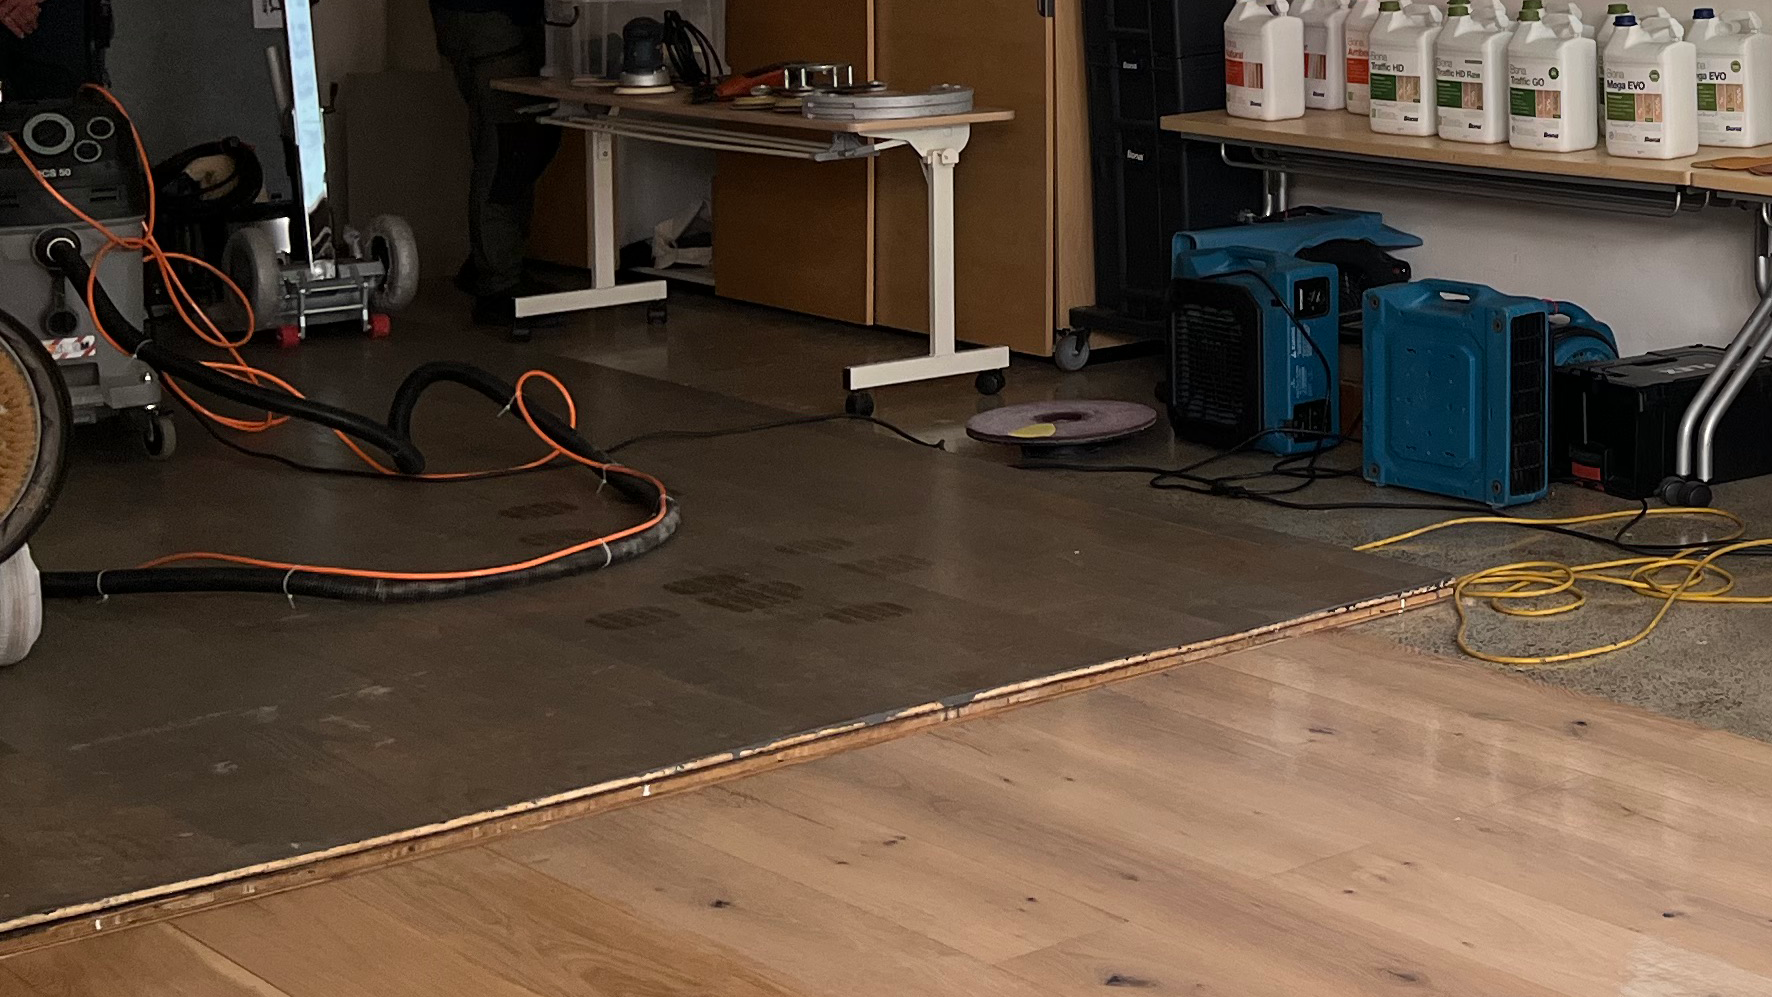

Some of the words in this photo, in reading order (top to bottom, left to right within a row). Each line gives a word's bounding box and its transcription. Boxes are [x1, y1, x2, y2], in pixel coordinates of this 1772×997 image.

[1371, 62, 1391, 72] Traffic
[1392, 64, 1404, 72] HD
[1437, 68, 1454, 77] Traffic
[1455, 68, 1465, 78] HD
[1709, 72, 1726, 80] EVO
[1511, 76, 1530, 86] Traffic
[1532, 77, 1544, 86] GO
[1607, 80, 1625, 91] Mega
[1628, 80, 1645, 90] EVO
[59, 168, 72, 176] 50
